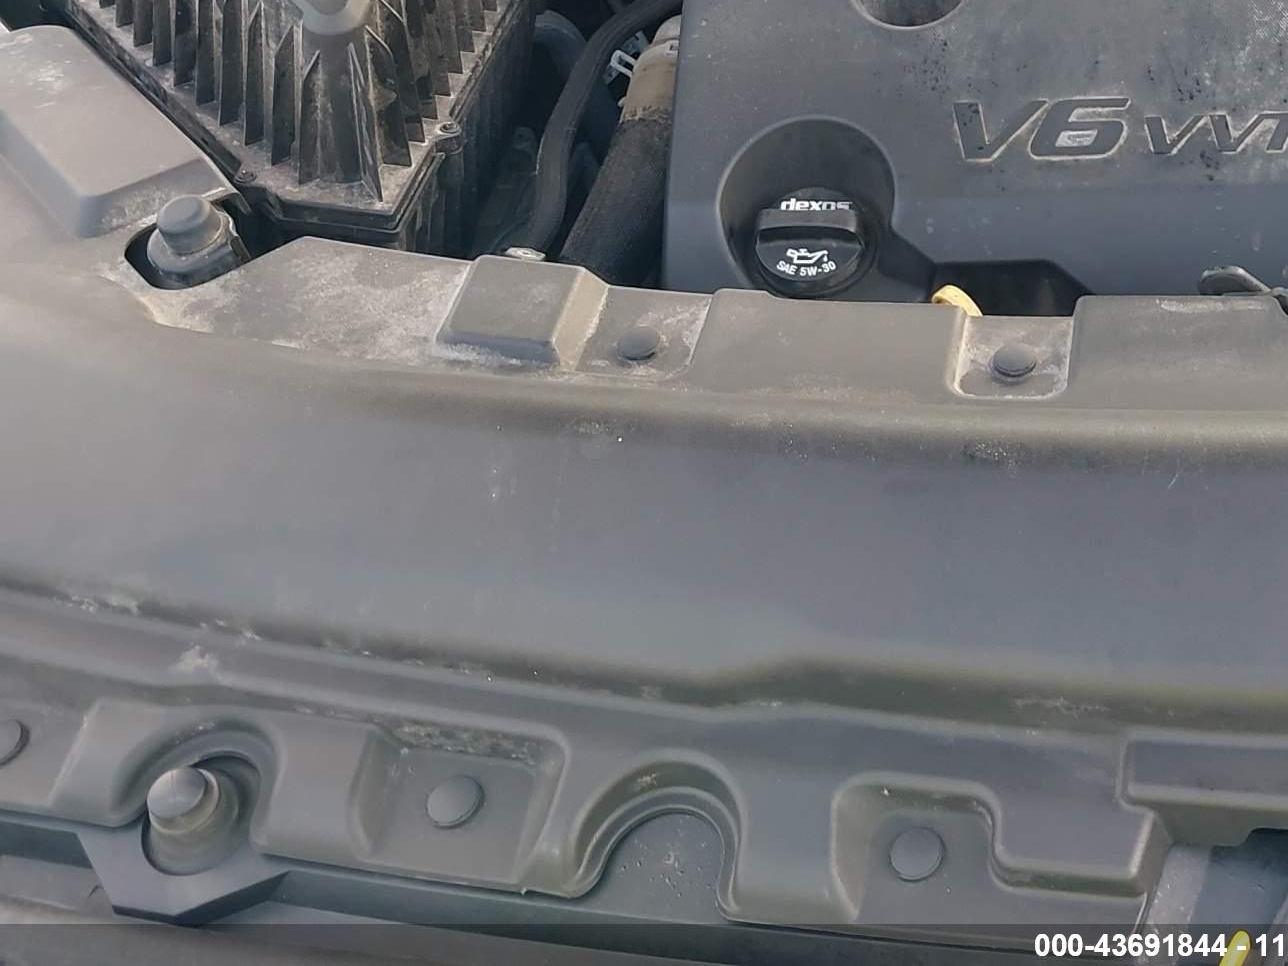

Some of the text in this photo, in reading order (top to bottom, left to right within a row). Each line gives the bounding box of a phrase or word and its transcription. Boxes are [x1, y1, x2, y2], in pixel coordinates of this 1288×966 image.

[952, 95, 1131, 162] V6
[780, 197, 850, 211] dexos
[776, 260, 837, 277] SAE 5W-30
